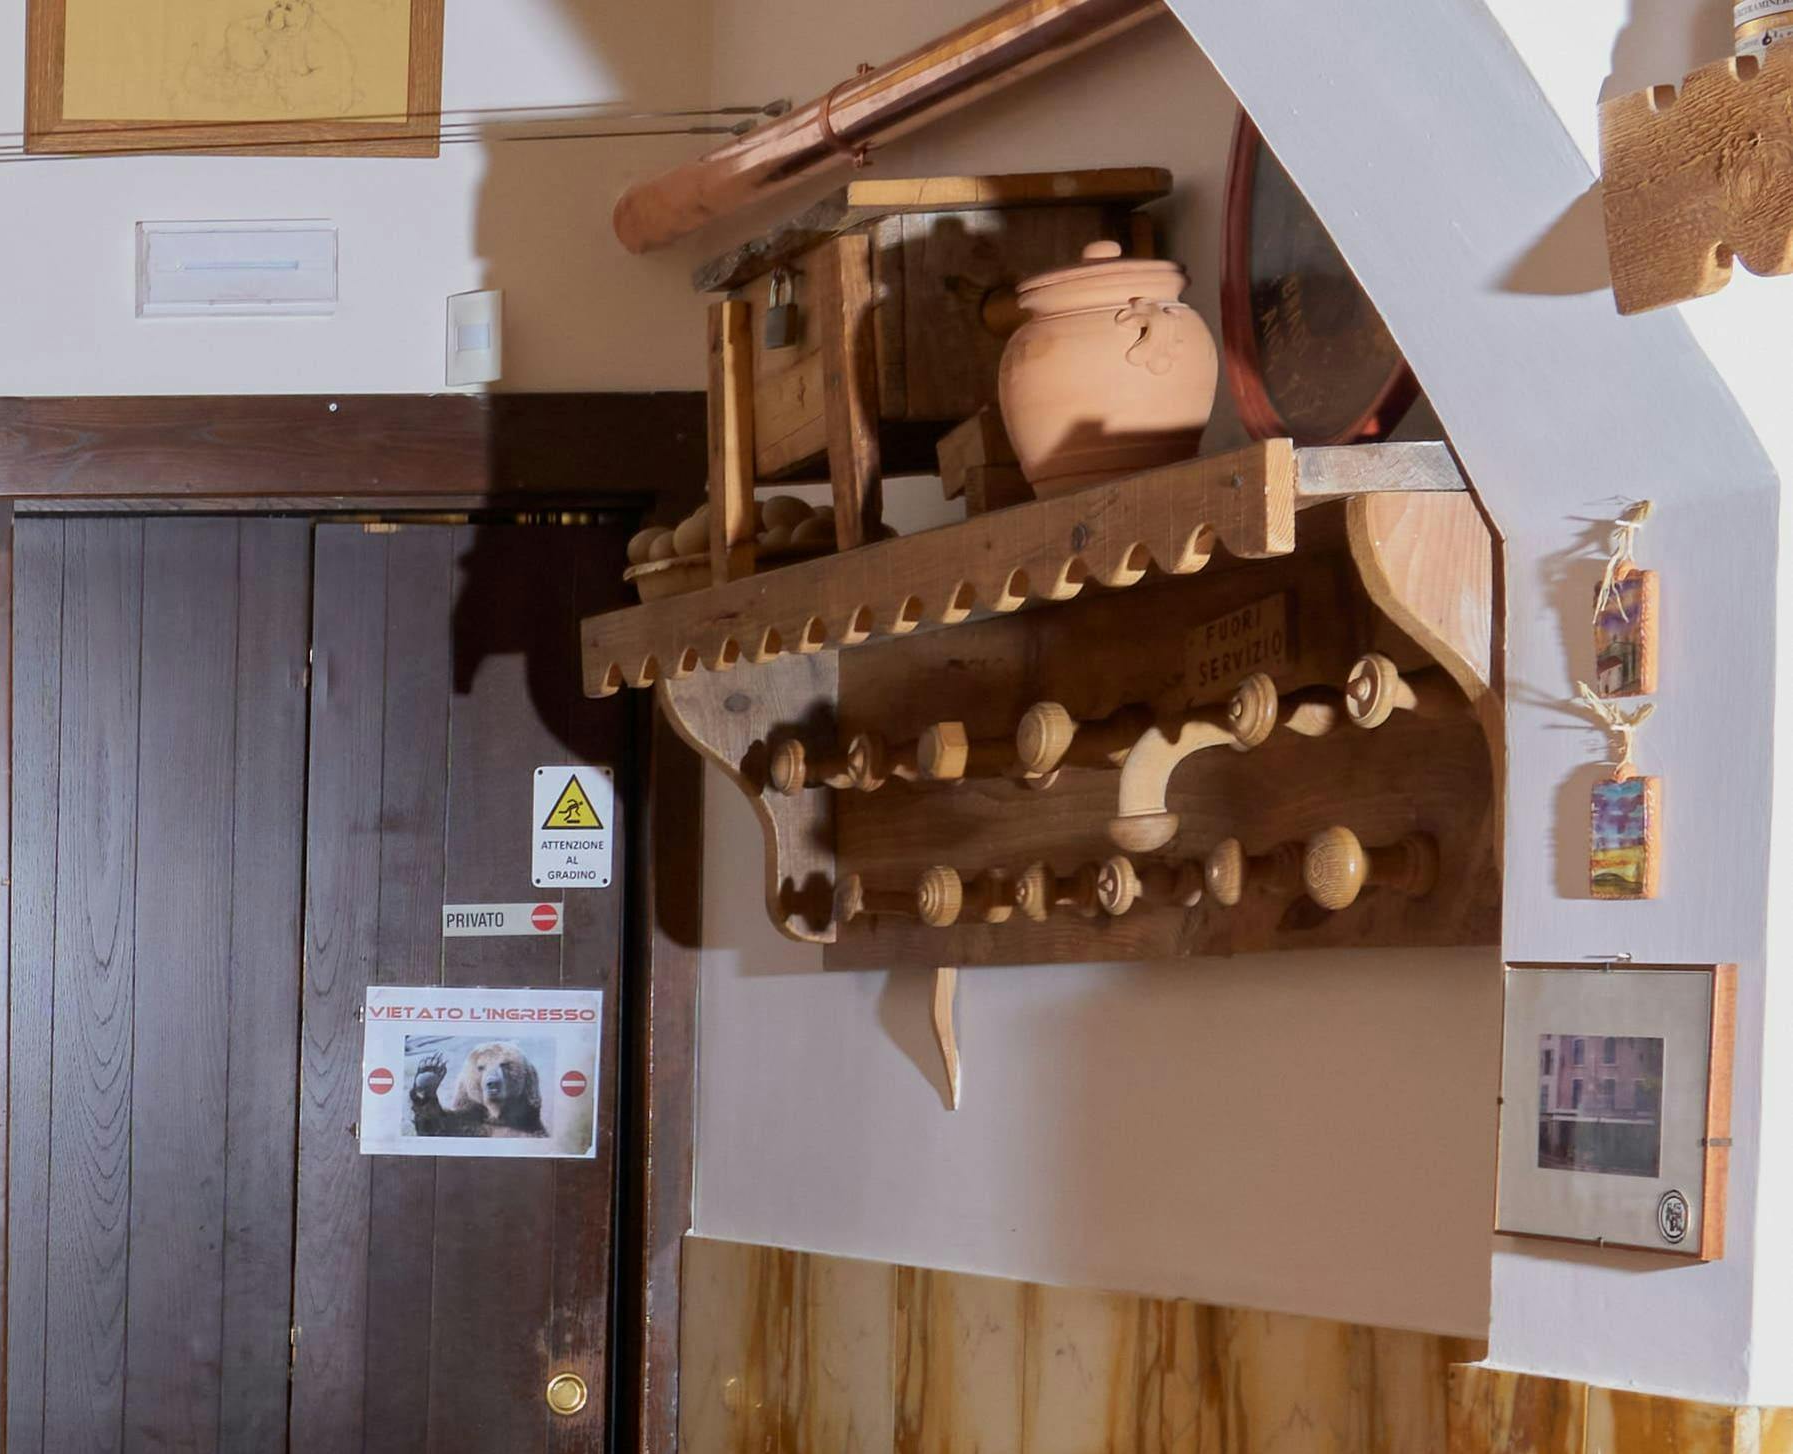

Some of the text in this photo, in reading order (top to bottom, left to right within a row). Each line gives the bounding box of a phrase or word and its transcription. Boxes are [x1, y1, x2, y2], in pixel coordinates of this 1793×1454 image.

[1205, 607, 1261, 651] FUORI
[1199, 630, 1281, 687] SERVIZIO
[540, 840, 605, 850] ATTENZIONE
[566, 855, 579, 865] AL
[547, 870, 597, 880] GRADINO
[446, 912, 504, 929] PRIVATO
[368, 1005, 596, 1021] VIETATO L'INGRESSO
